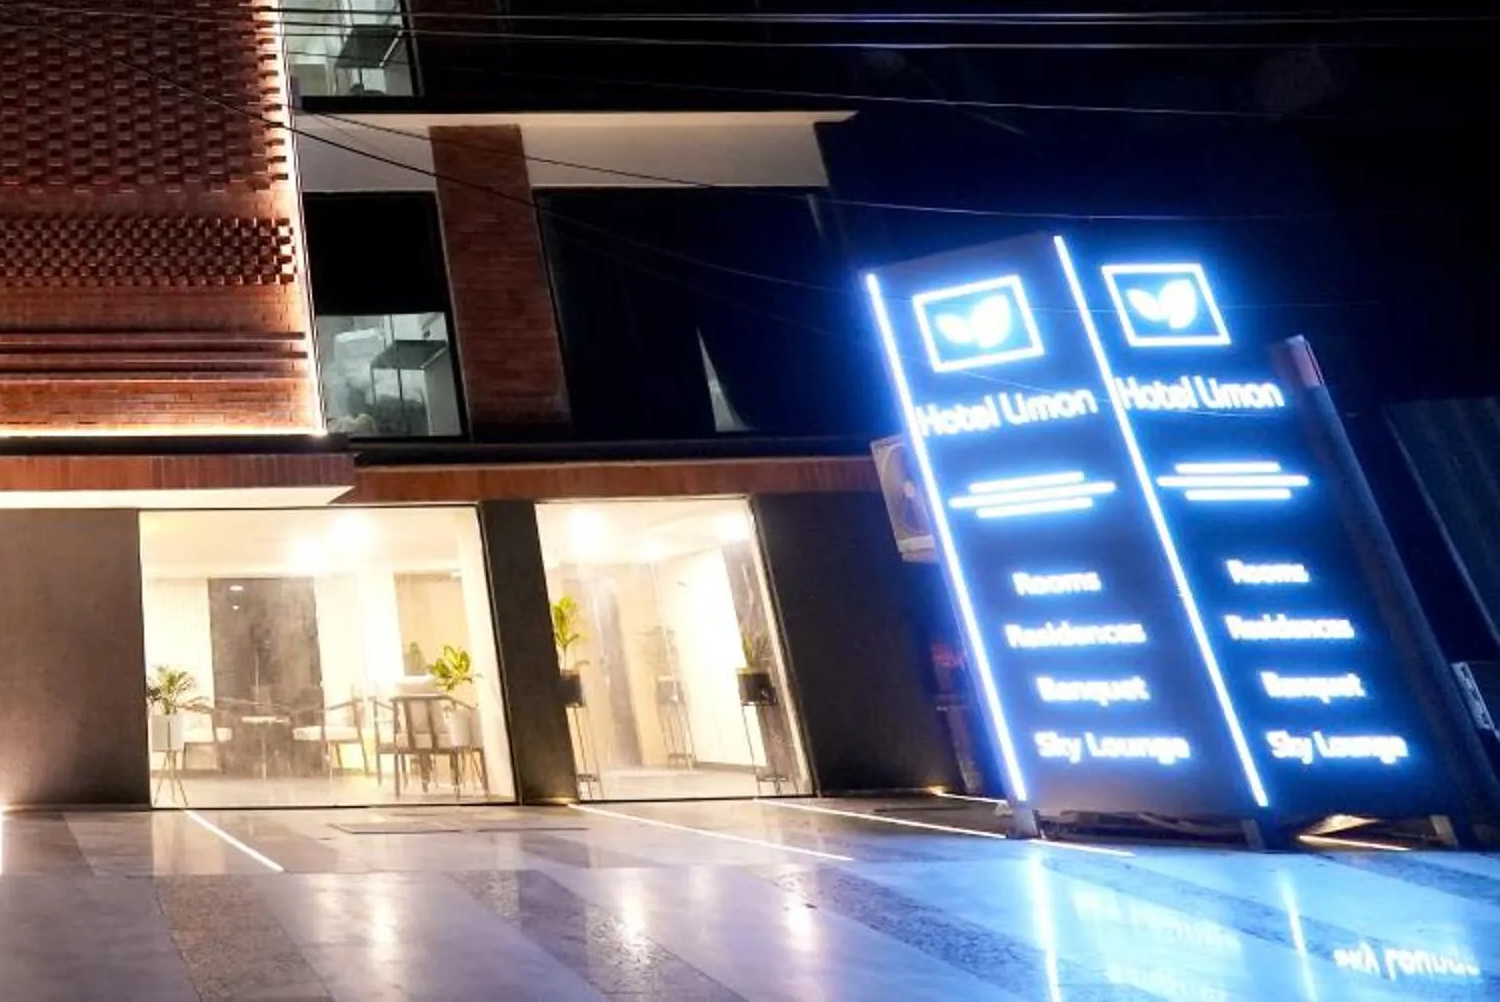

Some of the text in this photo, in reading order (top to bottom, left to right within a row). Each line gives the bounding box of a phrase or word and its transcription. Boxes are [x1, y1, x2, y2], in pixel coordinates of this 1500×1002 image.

[1116, 376, 1284, 410] Hotel Limon
[916, 388, 1097, 436] Hotel Limon
[1012, 572, 1102, 596] Rooms
[1227, 559, 1309, 584] Rooms
[1036, 677, 1151, 706] Banquet
[1034, 731, 1191, 765] Sky Lounge
[1266, 730, 1409, 764] Sky Lounge
